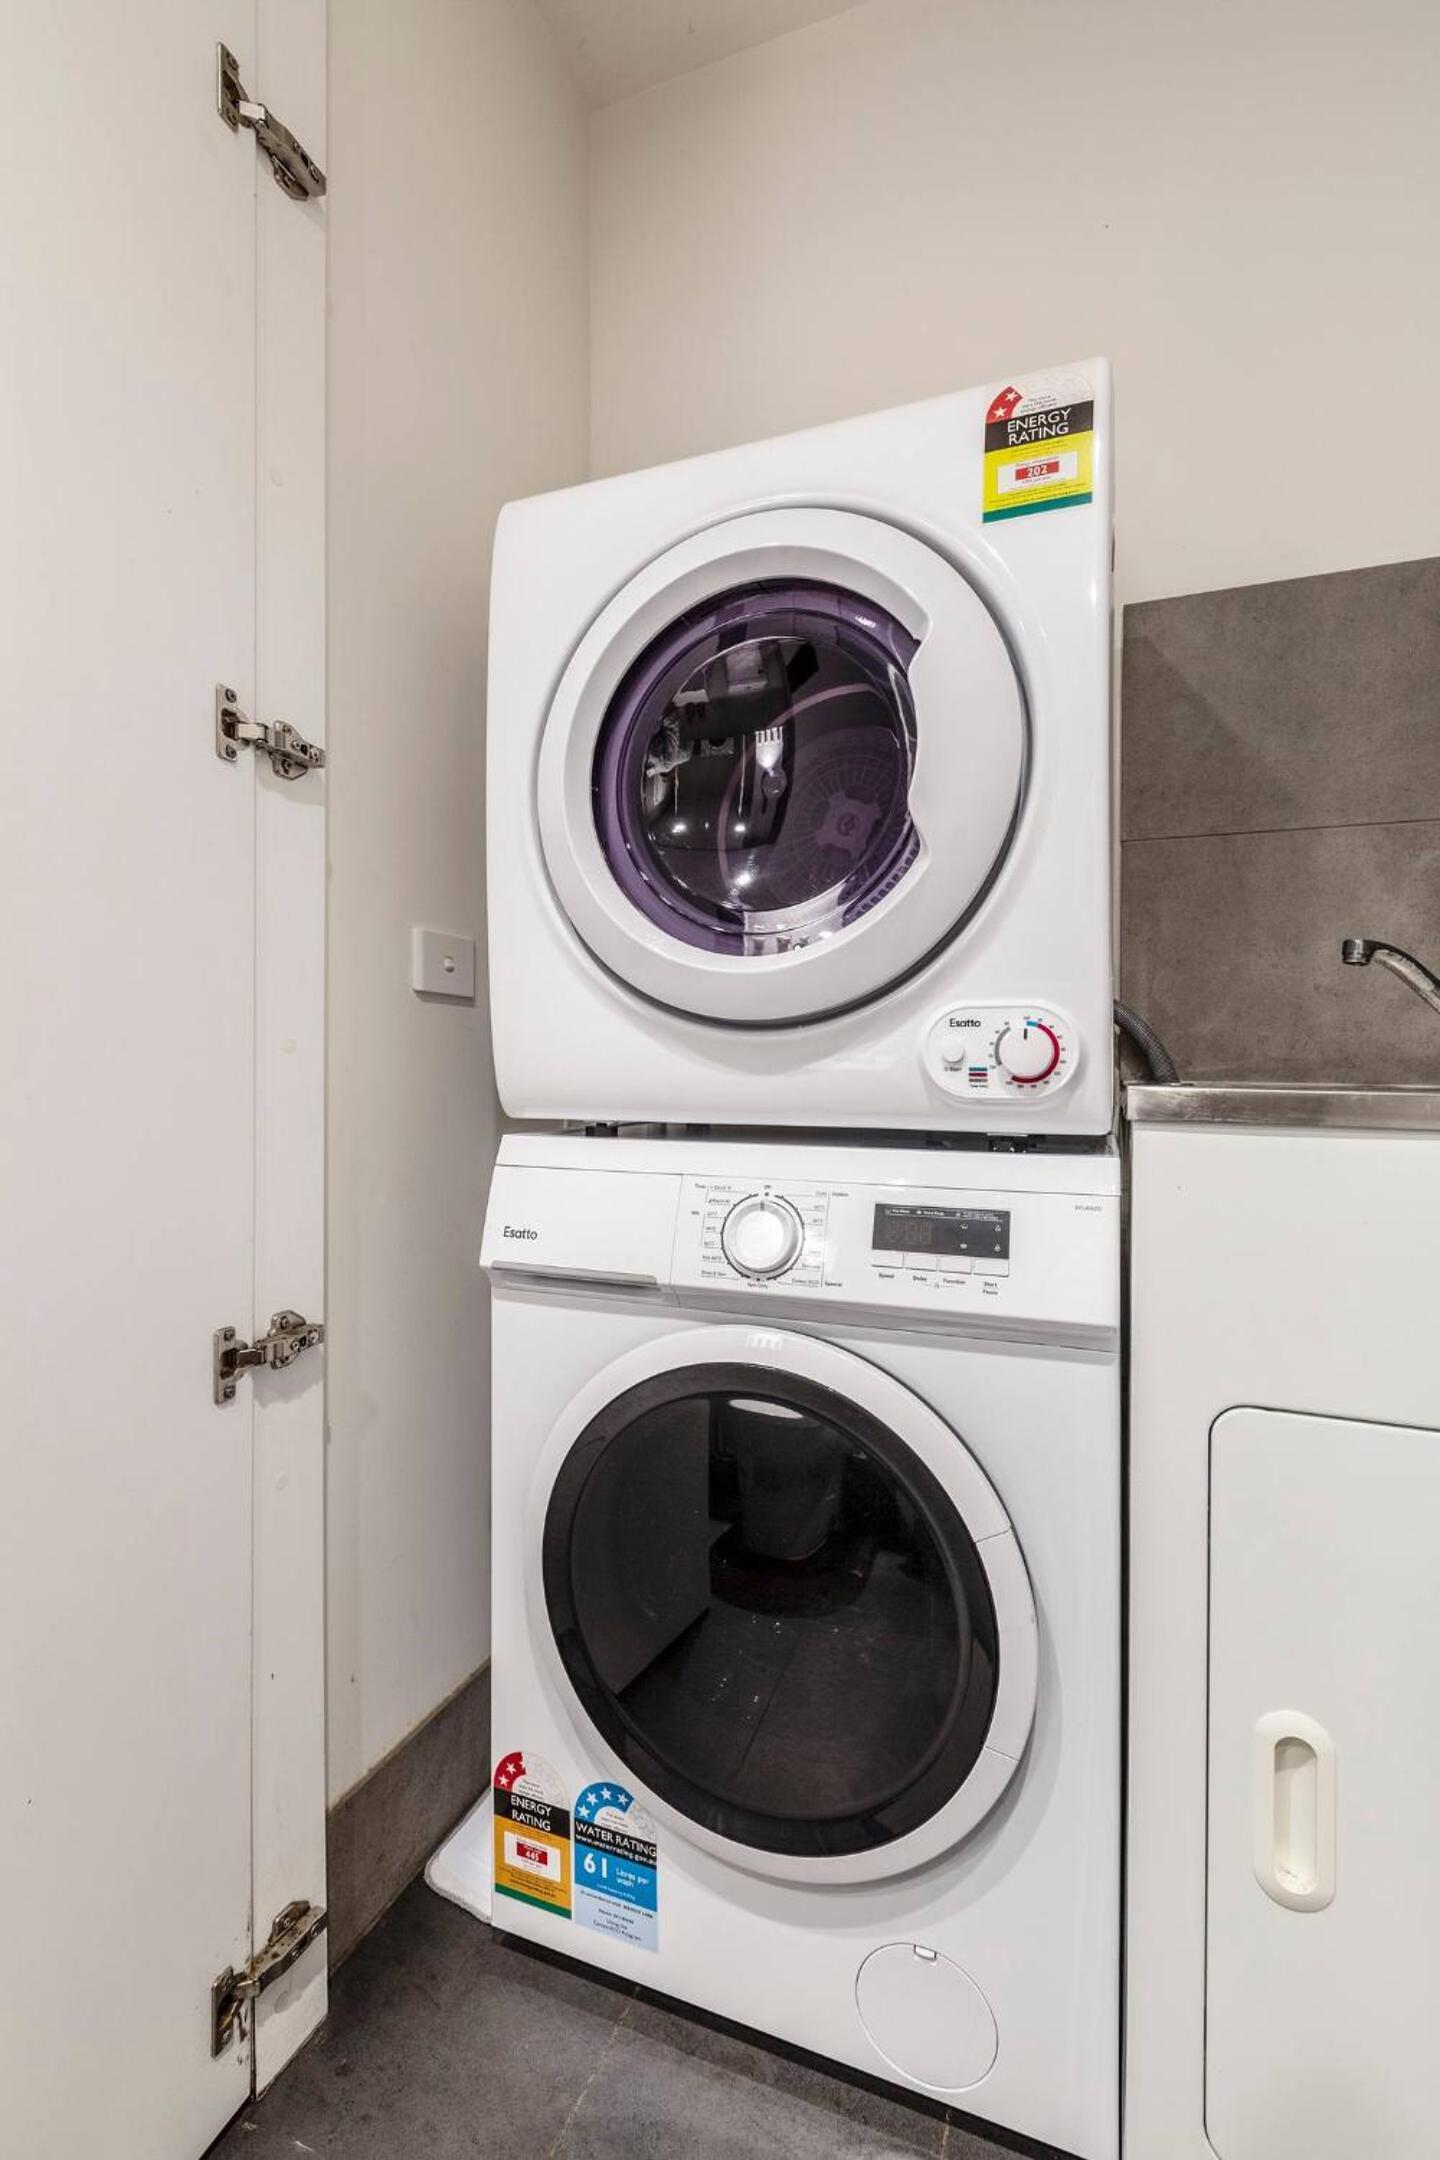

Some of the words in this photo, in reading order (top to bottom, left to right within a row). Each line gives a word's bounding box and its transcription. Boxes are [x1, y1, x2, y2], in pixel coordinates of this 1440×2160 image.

[1007, 407, 1072, 433] ENERGY
[1008, 422, 1069, 446] RATING
[1026, 464, 1049, 477] 202
[949, 1018, 981, 1028] Esatto
[503, 1225, 538, 1240] Esatto
[510, 1794, 552, 1817] ENERGY
[512, 1809, 551, 1831] RATING
[575, 1821, 614, 1843] WATER
[615, 1834, 657, 1857] RATING
